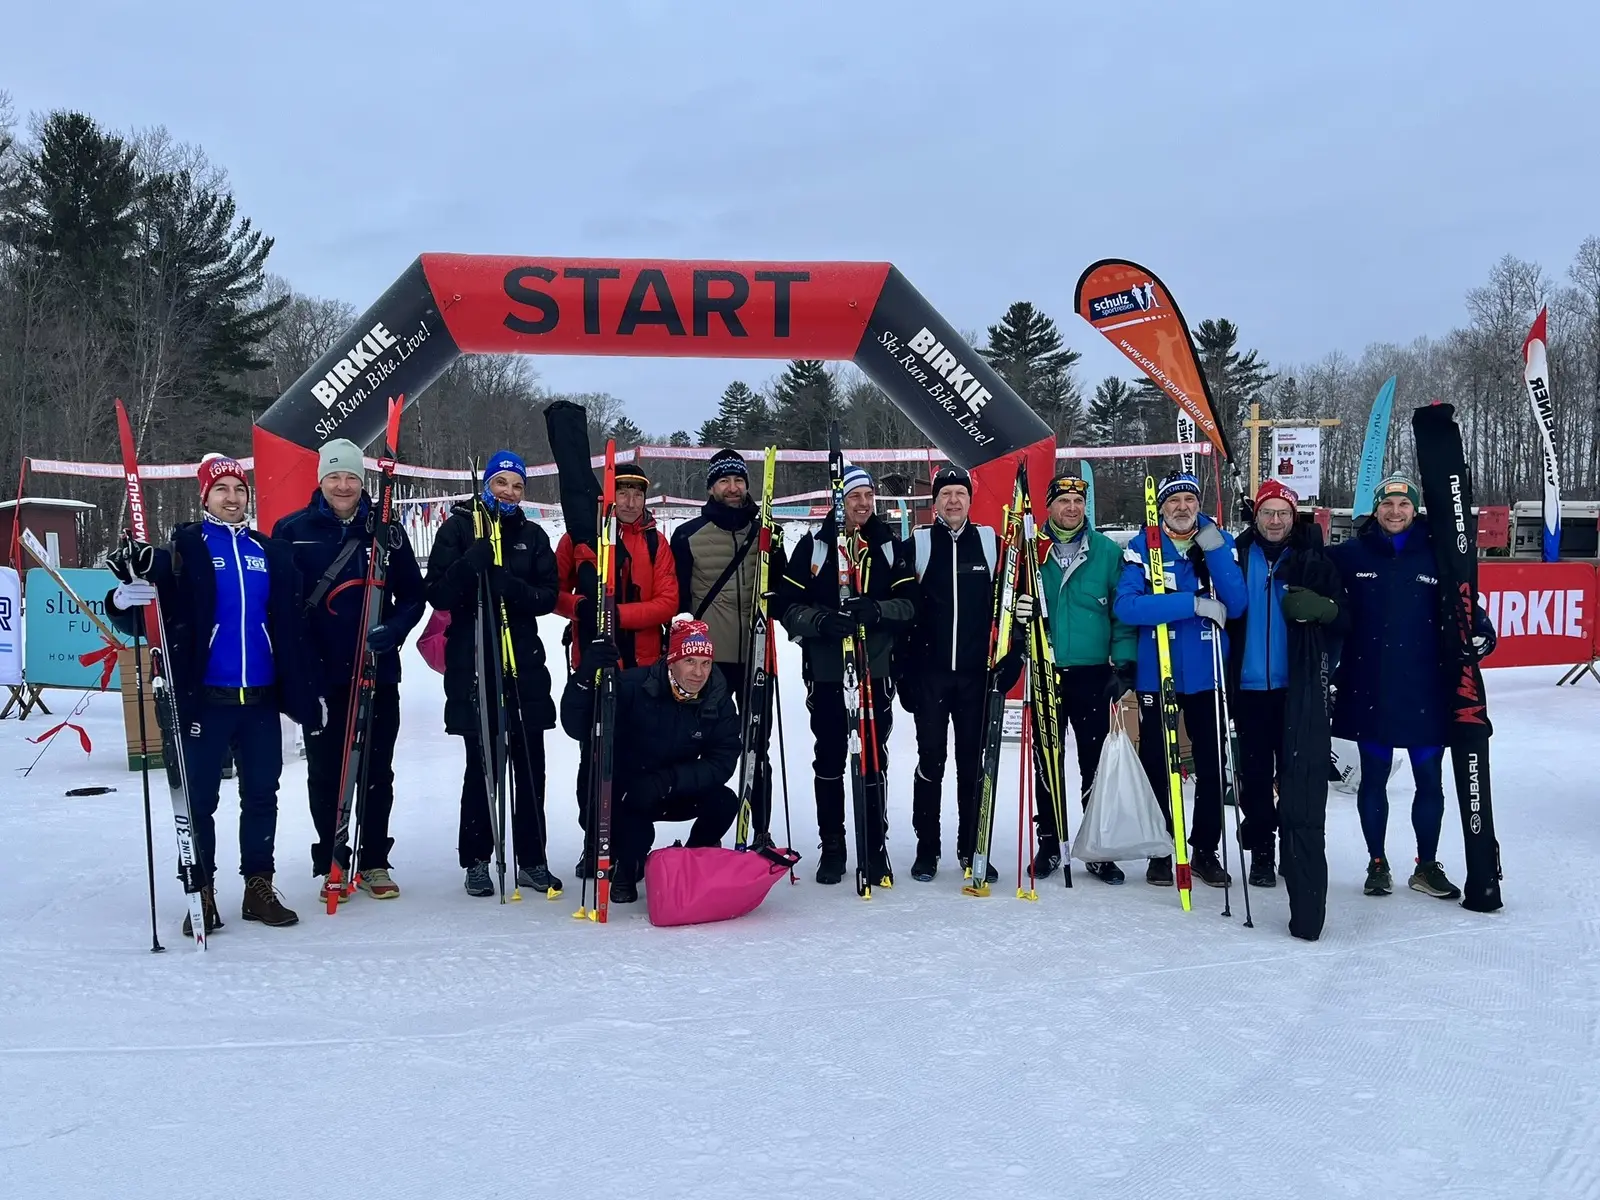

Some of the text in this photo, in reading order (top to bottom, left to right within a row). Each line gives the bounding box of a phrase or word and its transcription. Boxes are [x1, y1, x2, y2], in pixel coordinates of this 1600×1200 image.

[503, 265, 810, 338] START
[1094, 294, 1130, 312] schulz
[311, 322, 398, 409] BIRKIE
[907, 326, 993, 415] BIRKIE
[1119, 338, 1214, 431] www.schulz-sportreisen.de
[211, 465, 244, 479] LOPPET
[127, 473, 150, 543] MADSHUS
[381, 485, 392, 523] ROSSIGNOL
[1450, 474, 1465, 532] SUBARU
[681, 646, 713, 656] LOPPET
[1470, 753, 1479, 812] SUBARU
[175, 815, 191, 837] 3.0
